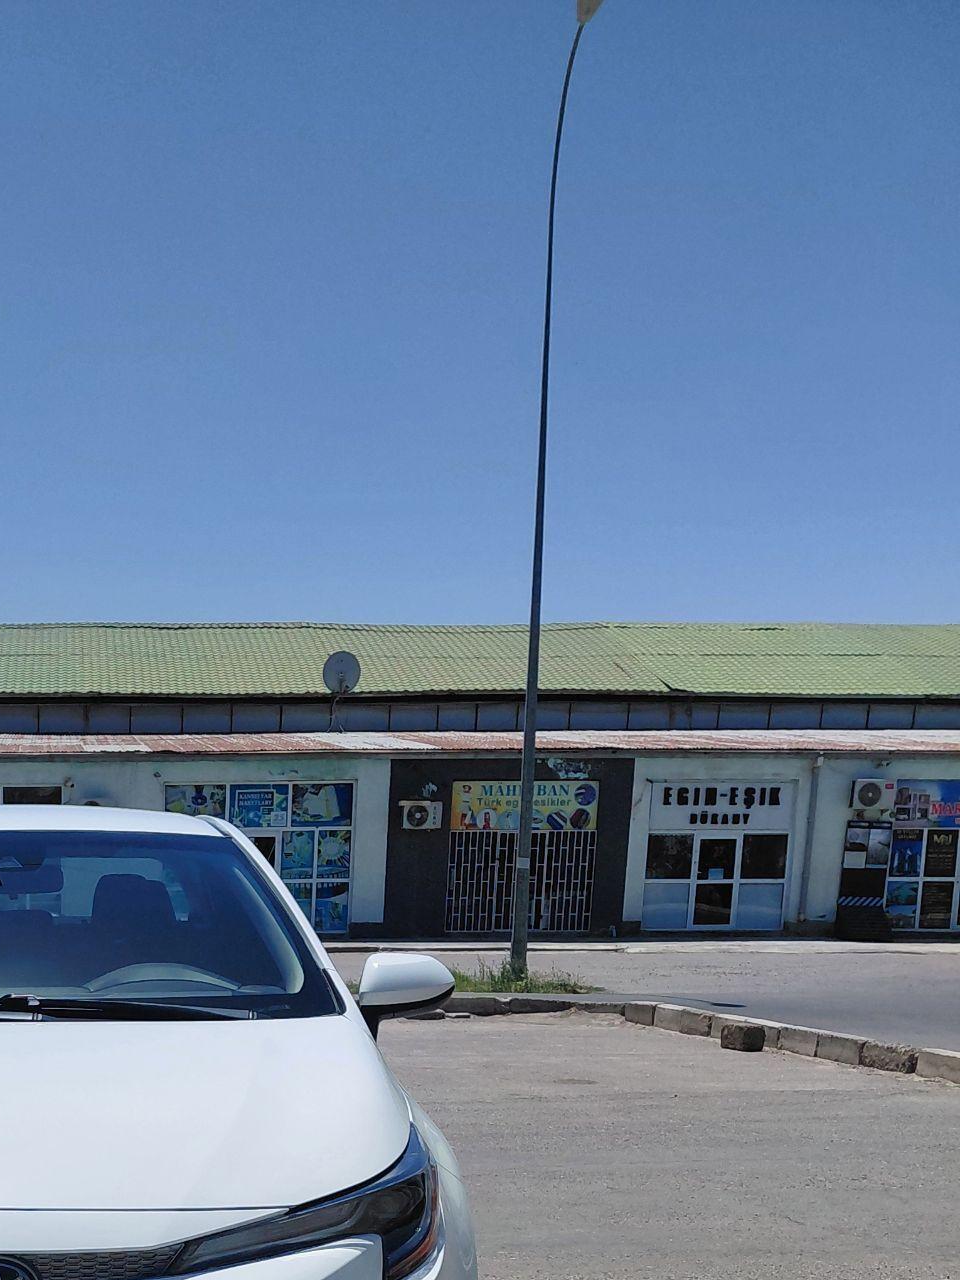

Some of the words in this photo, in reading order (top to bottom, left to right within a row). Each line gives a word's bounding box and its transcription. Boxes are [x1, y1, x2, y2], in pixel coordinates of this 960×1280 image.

[481, 782, 570, 796] MÄHBAN
[477, 797, 502, 807] Türk
[663, 787, 781, 809] EGIN-EŞIK
[690, 811, 750, 824] DÜKANY
